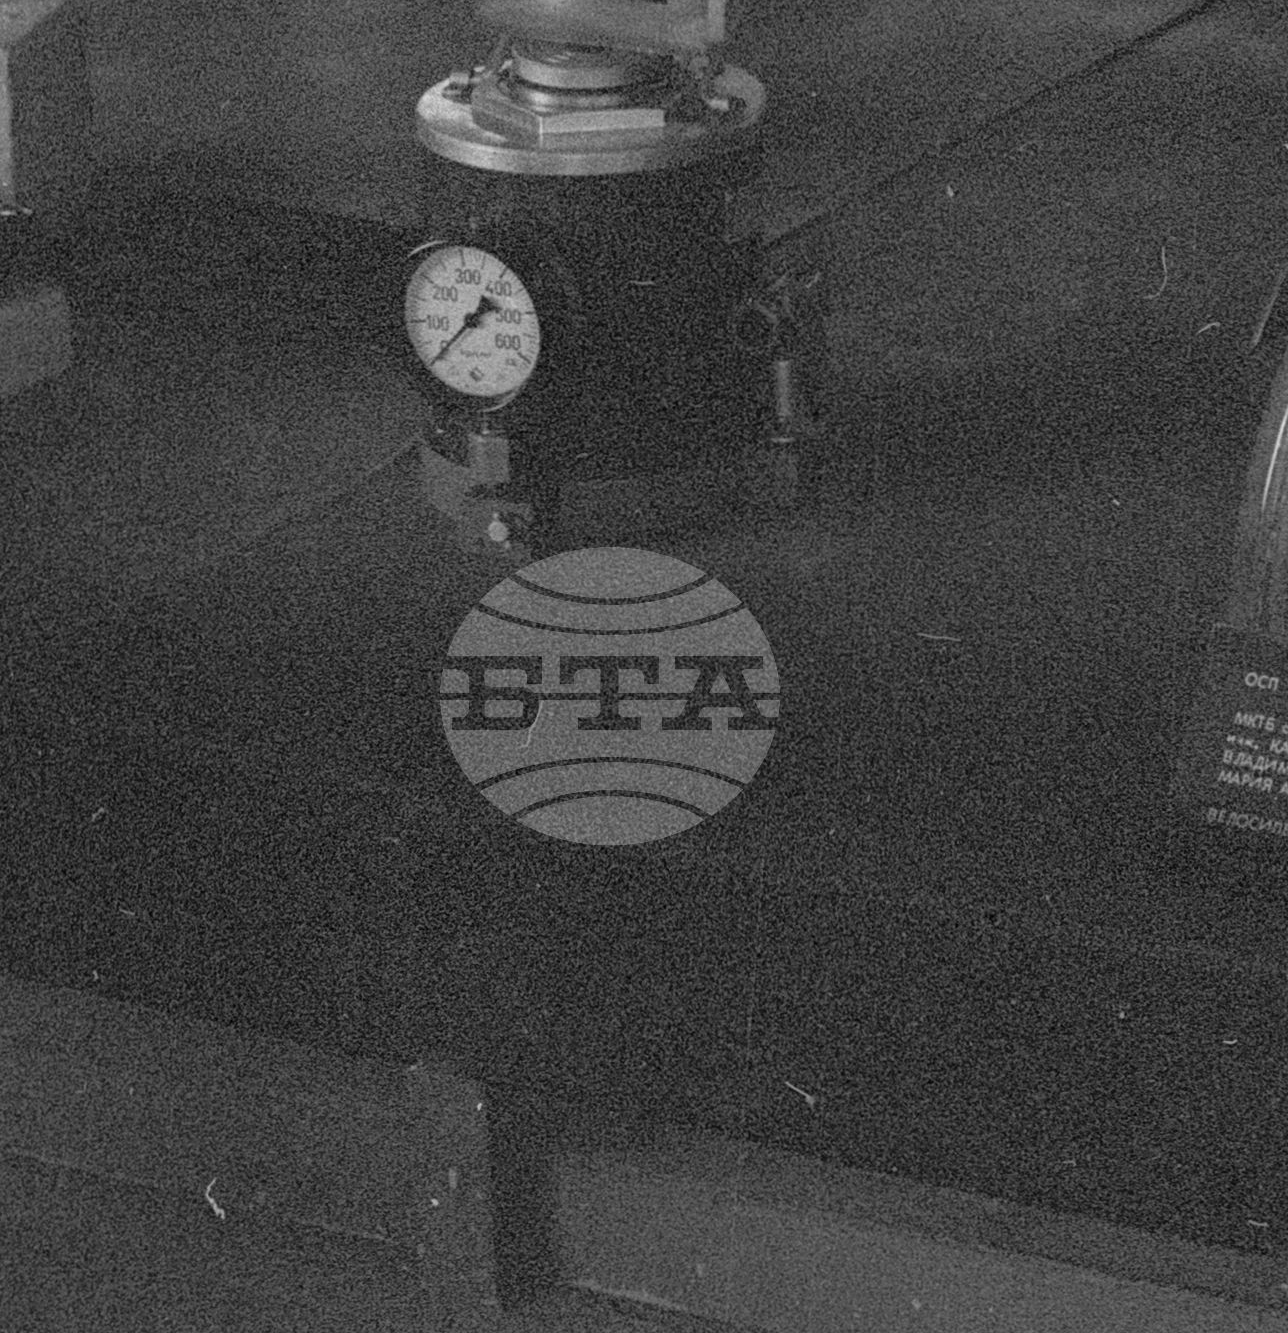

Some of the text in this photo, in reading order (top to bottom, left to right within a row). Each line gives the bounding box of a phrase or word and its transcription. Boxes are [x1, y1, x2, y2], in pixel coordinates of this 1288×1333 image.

[455, 267, 481, 285] 300
[433, 284, 458, 302] 200
[485, 280, 512, 297] 400
[427, 314, 450, 331] 100
[494, 334, 521, 351] 600
[1244, 672, 1279, 691] ОСП
[1218, 770, 1273, 794] МАРИЯ
